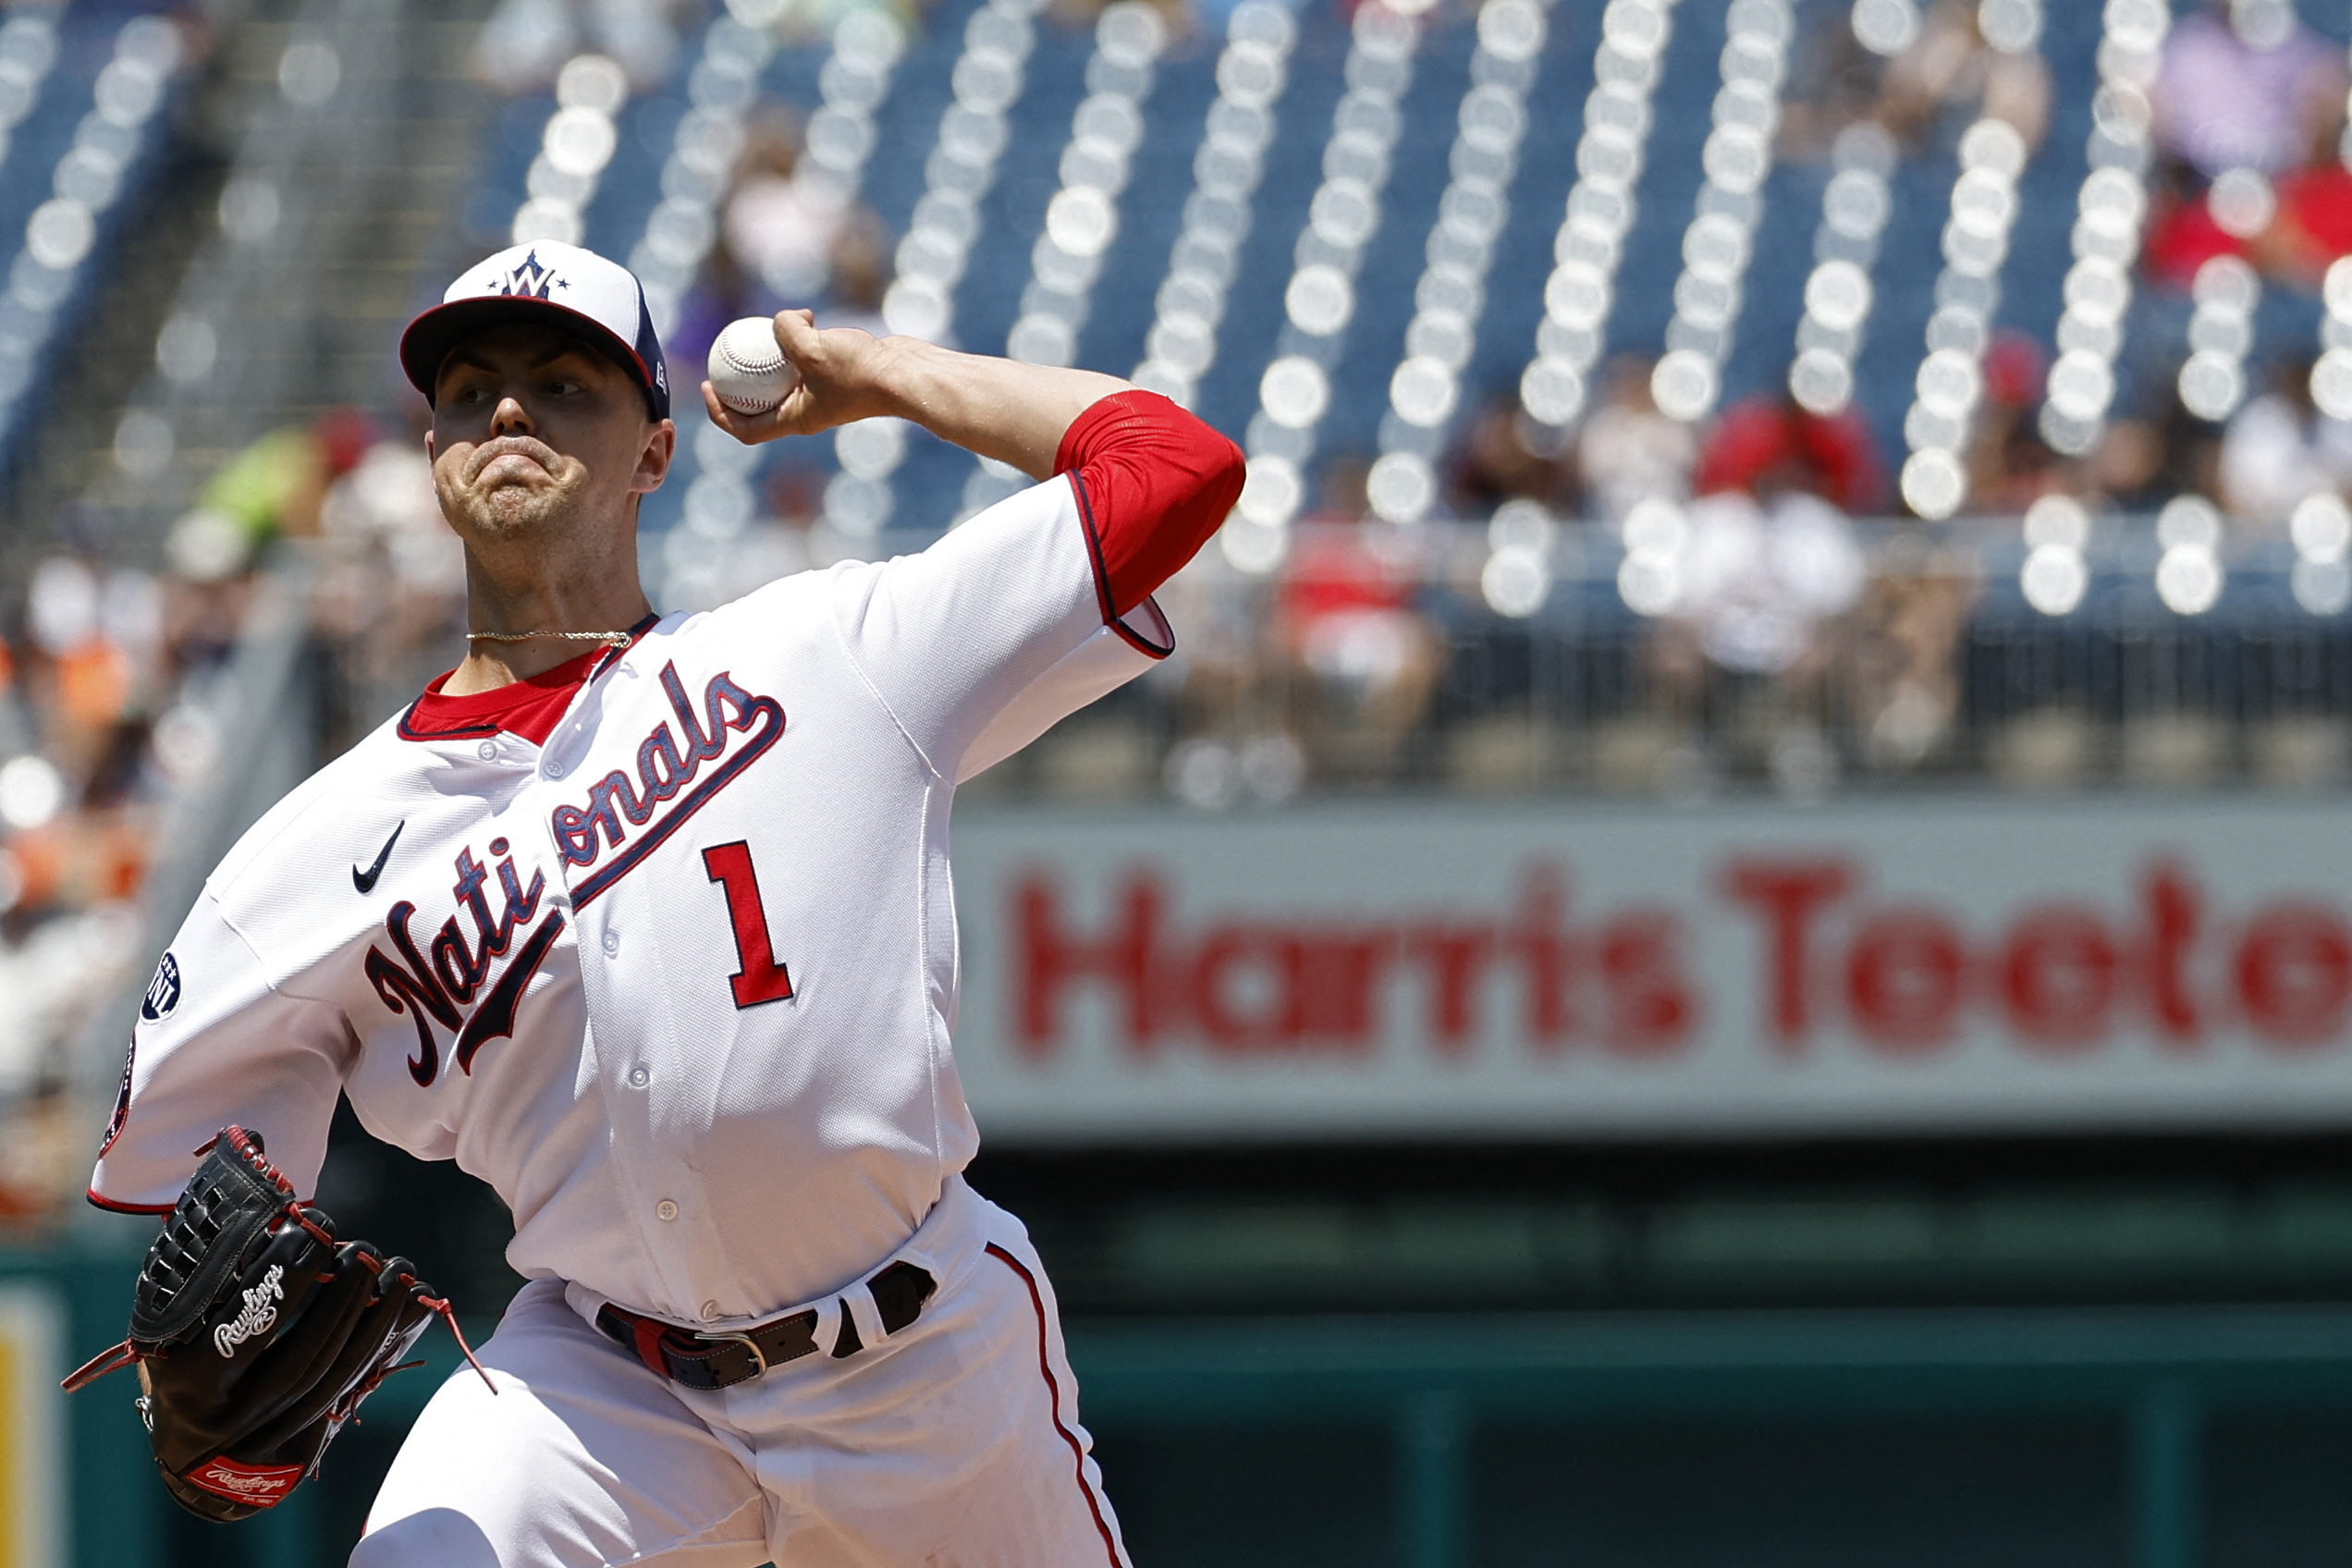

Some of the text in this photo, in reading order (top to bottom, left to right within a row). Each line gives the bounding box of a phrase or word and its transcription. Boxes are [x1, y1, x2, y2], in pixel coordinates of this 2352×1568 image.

[364, 657, 786, 1087] Nationals
[701, 839, 794, 1011] 1
[1001, 860, 1697, 1061] Harris
[214, 1264, 284, 1358] Rawlings
[205, 1470, 287, 1493] Rawlings
